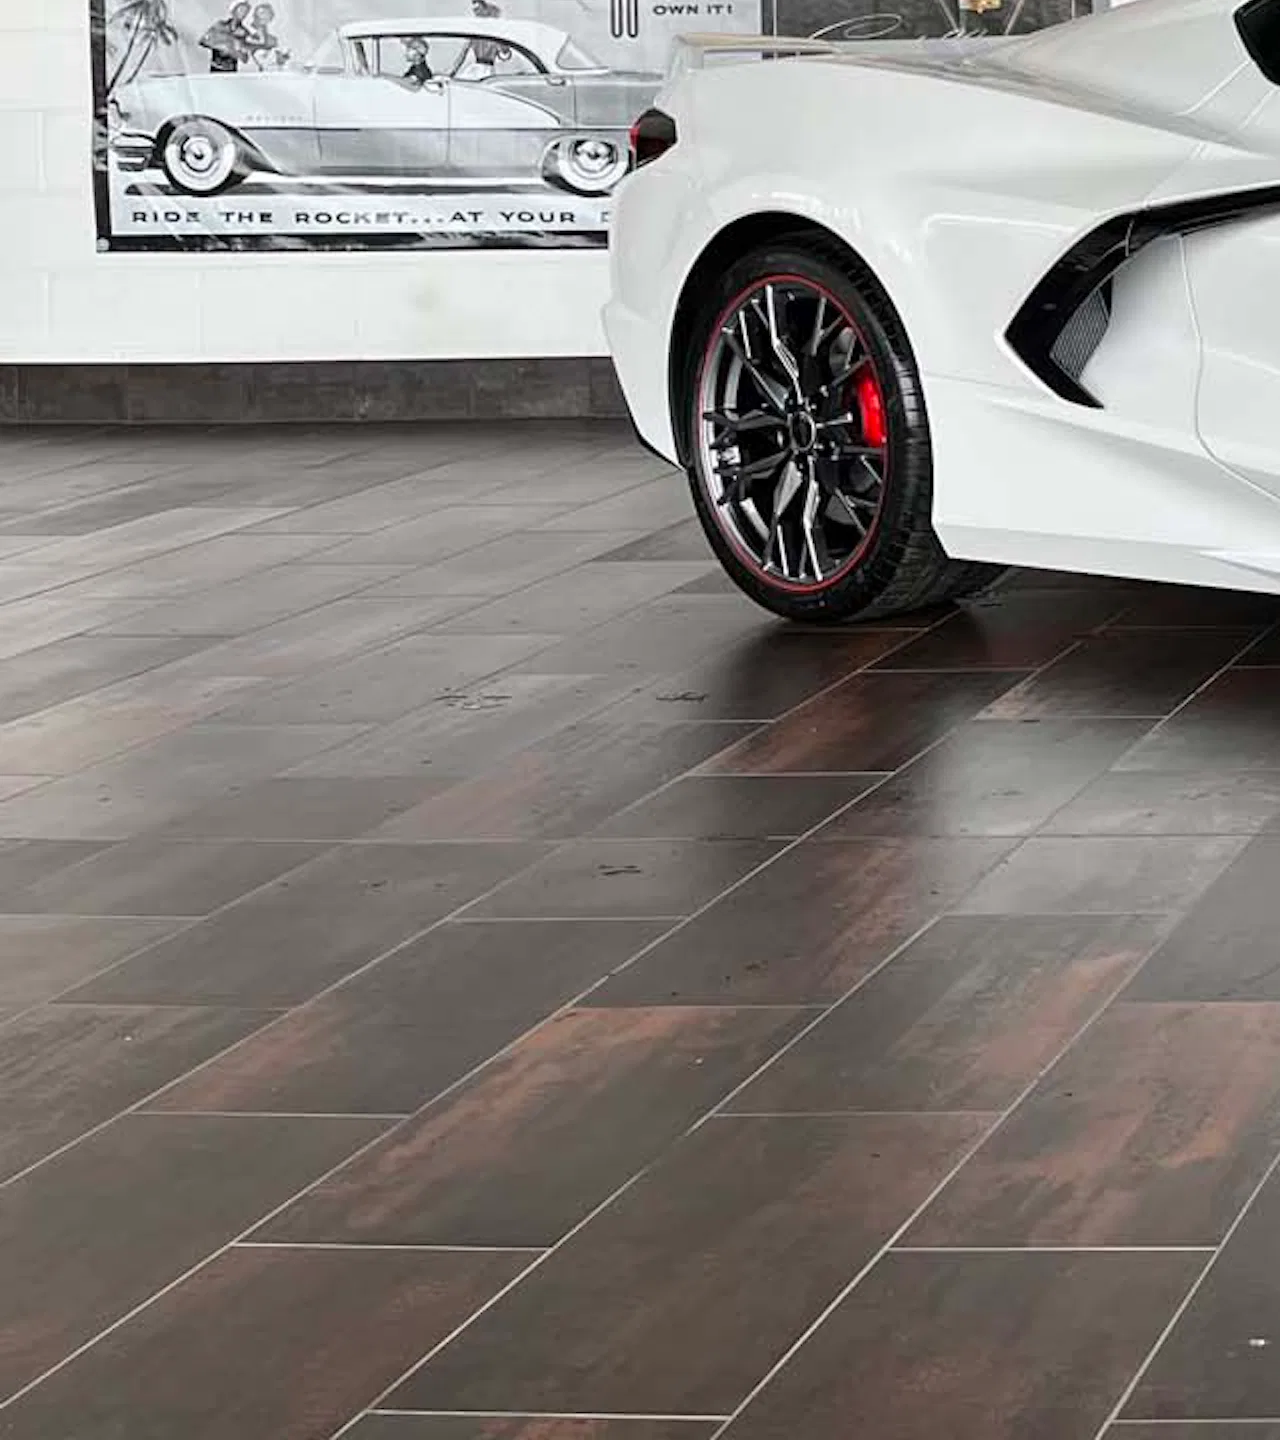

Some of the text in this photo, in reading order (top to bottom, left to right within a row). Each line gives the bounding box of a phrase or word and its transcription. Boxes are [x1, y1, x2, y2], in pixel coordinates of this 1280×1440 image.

[652, 3, 733, 15] OWN IT!
[132, 210, 201, 223] RIDE
[219, 210, 273, 223] THE
[500, 210, 577, 223] YOUR
